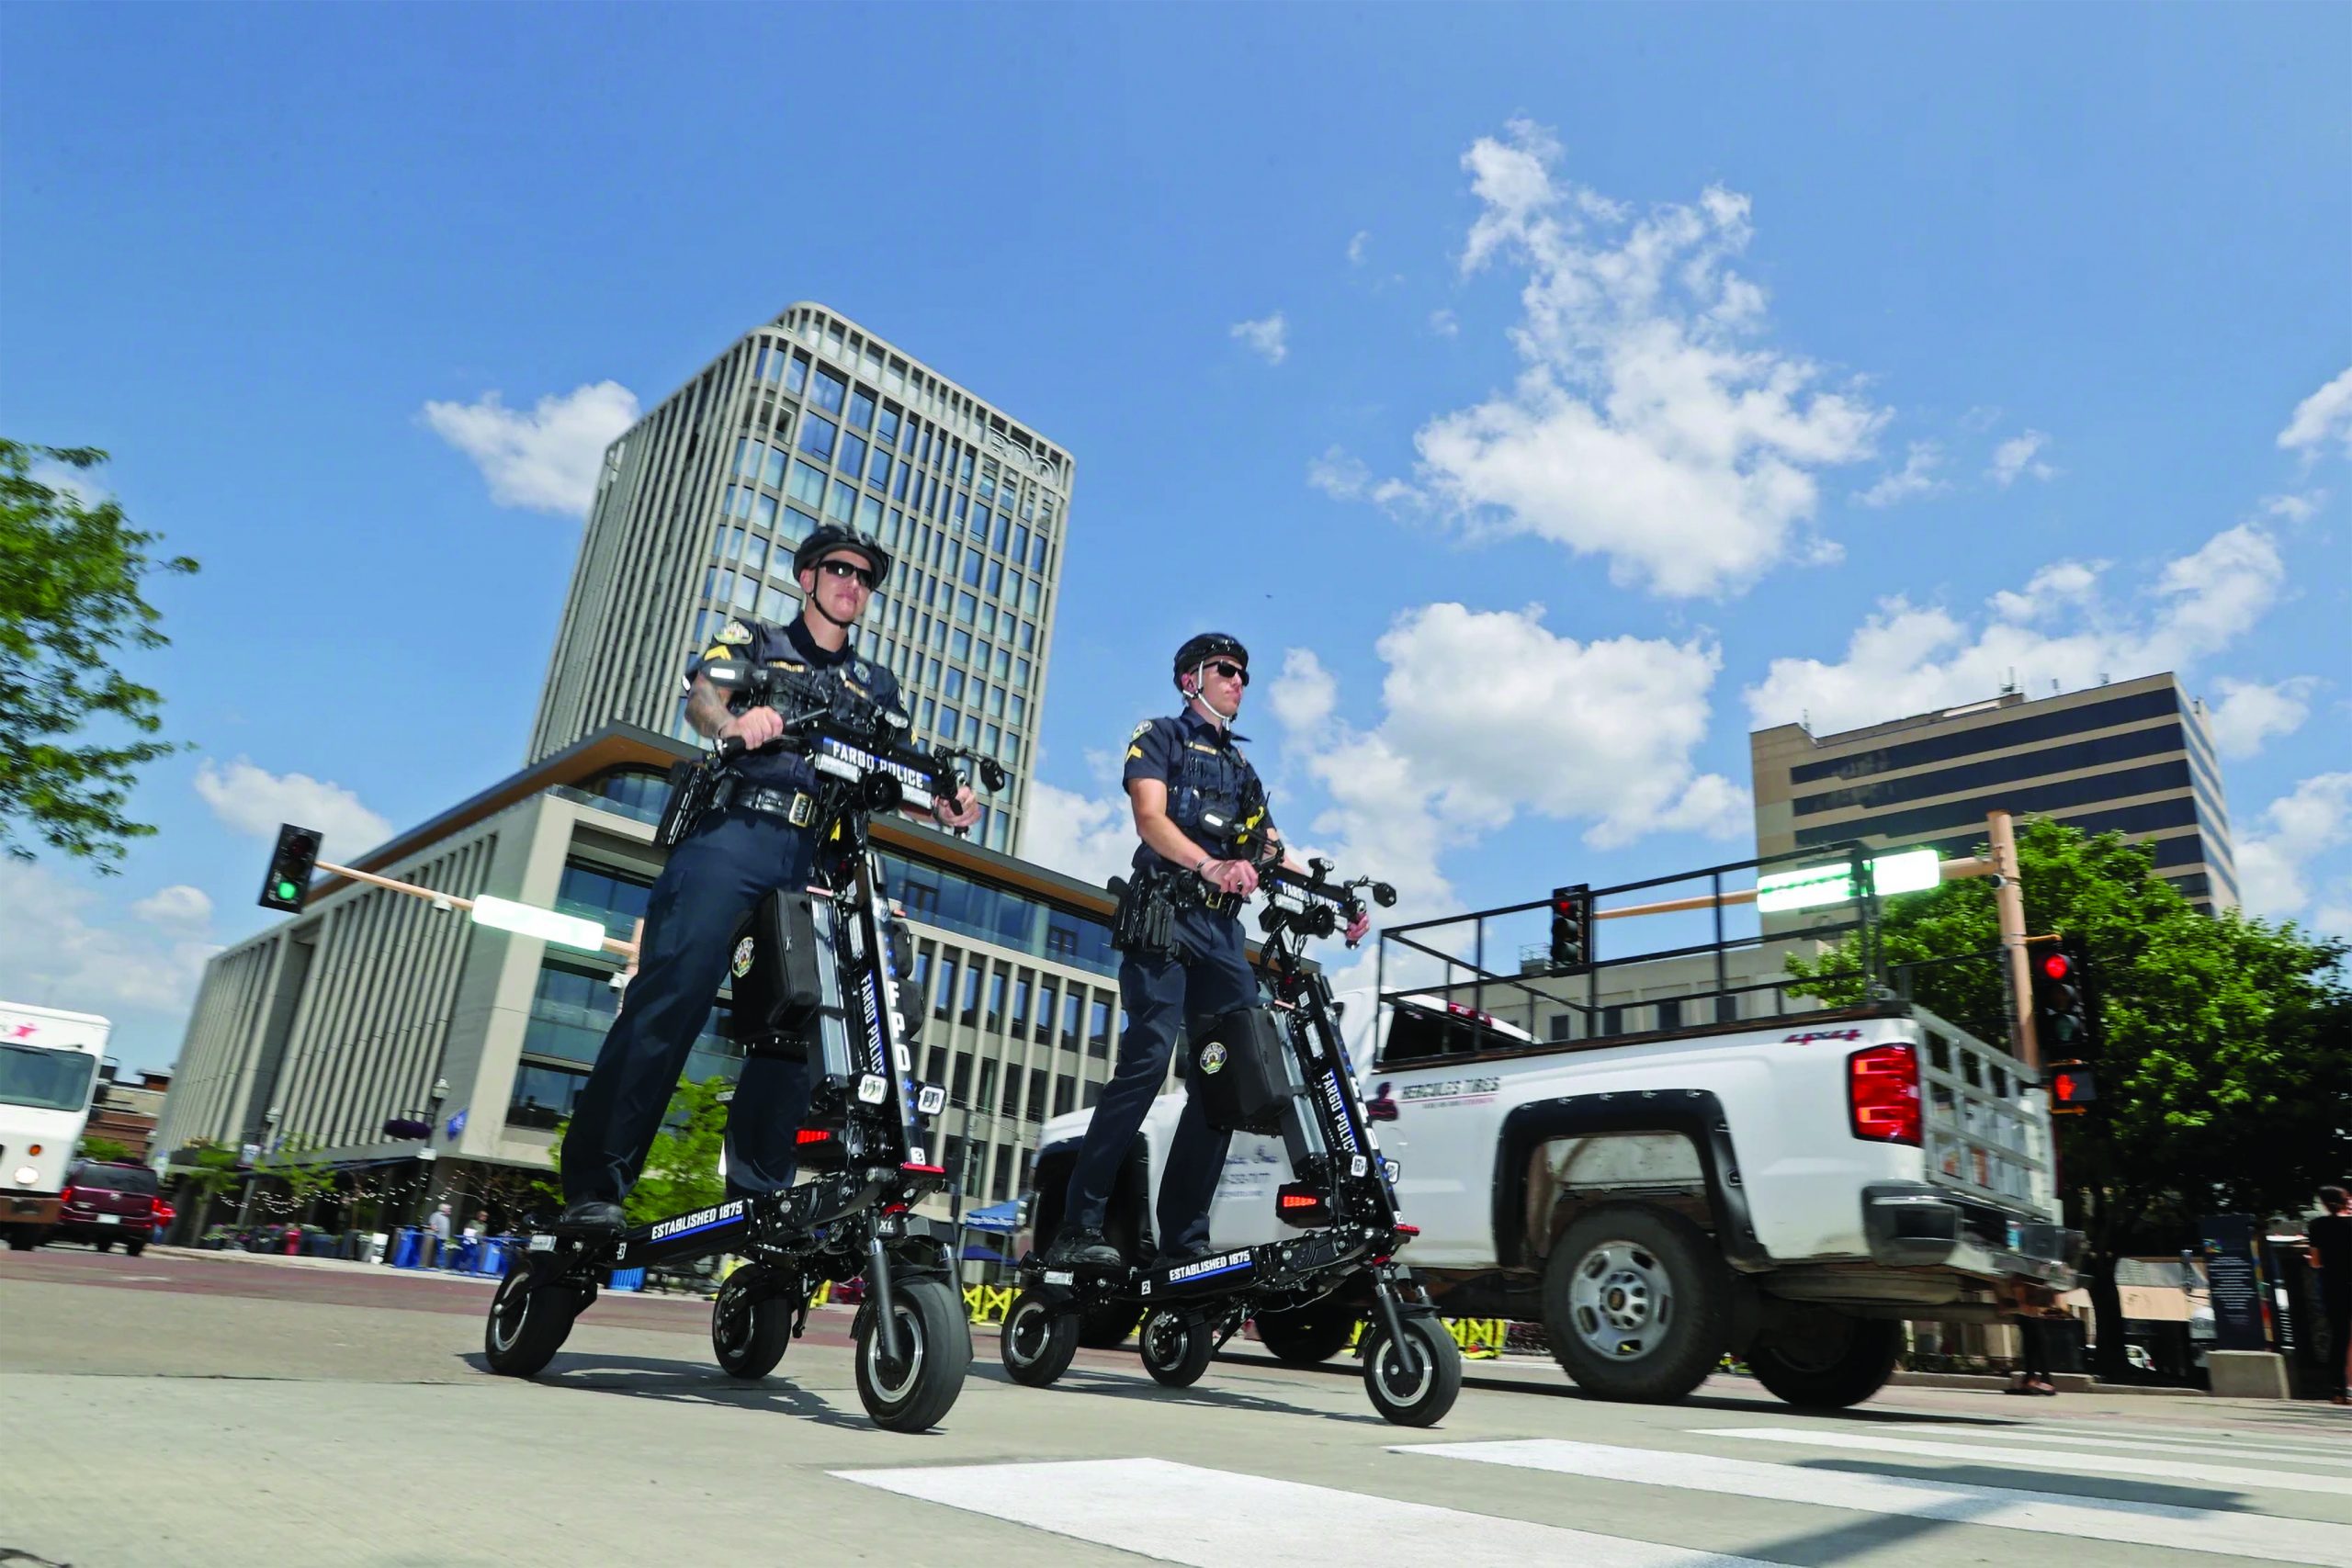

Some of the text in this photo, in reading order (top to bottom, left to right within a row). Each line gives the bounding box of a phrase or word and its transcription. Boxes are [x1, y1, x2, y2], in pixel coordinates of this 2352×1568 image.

[832, 740, 924, 789] FARGO POLICE
[861, 974, 876, 1024] FARGO
[888, 980, 911, 1072] FPD
[1321, 1071, 1343, 1112] FARGO
[650, 1200, 743, 1240] ESTABLISHED 1875
[1169, 1250, 1250, 1281] ESTABLISHED 1875
